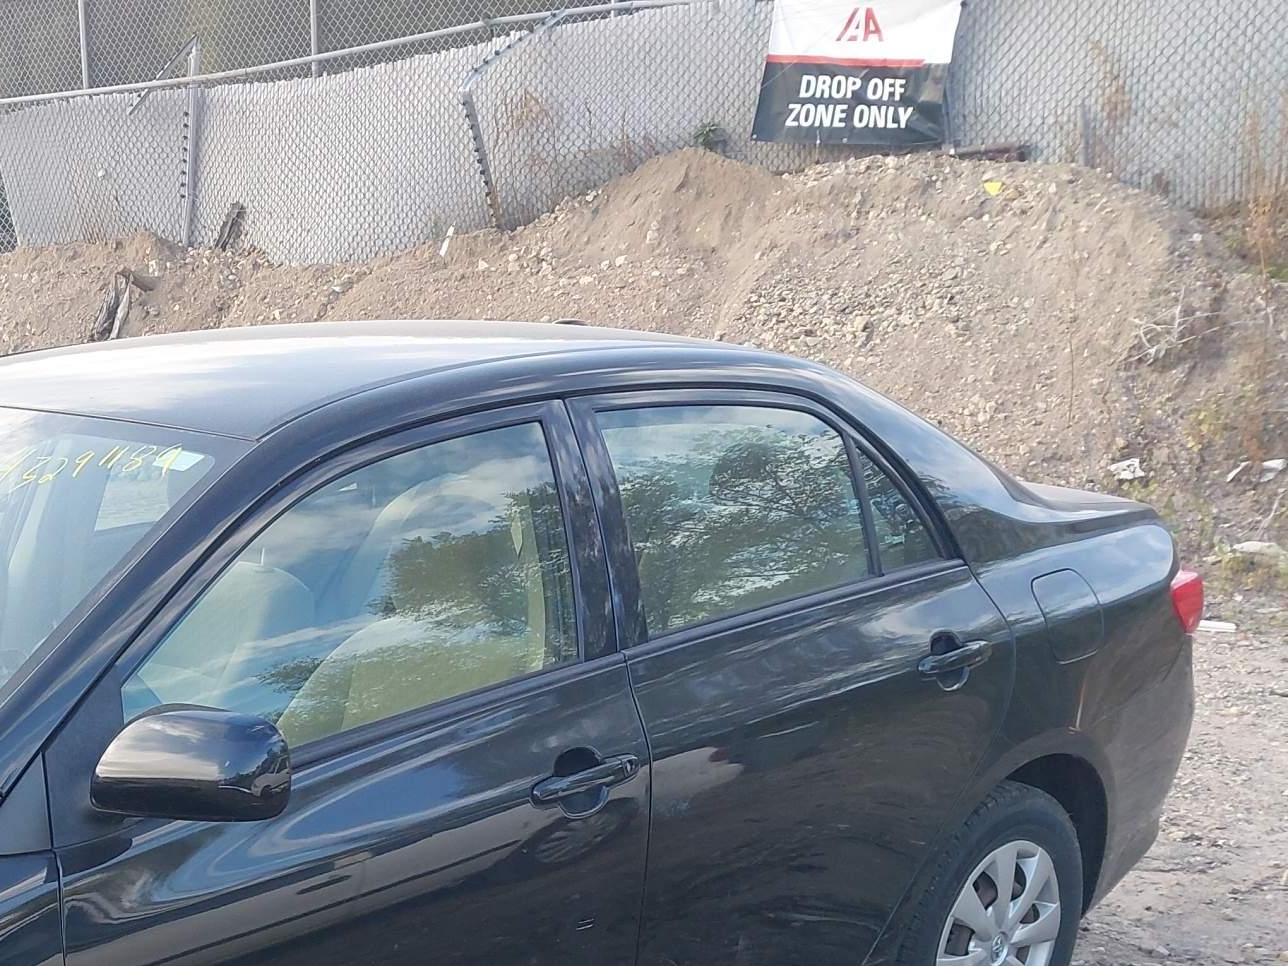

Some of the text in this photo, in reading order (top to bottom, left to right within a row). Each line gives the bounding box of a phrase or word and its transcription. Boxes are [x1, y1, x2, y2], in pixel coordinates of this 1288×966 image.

[799, 74, 906, 101] DROP OFF
[785, 104, 913, 129] ZONE ONLY
